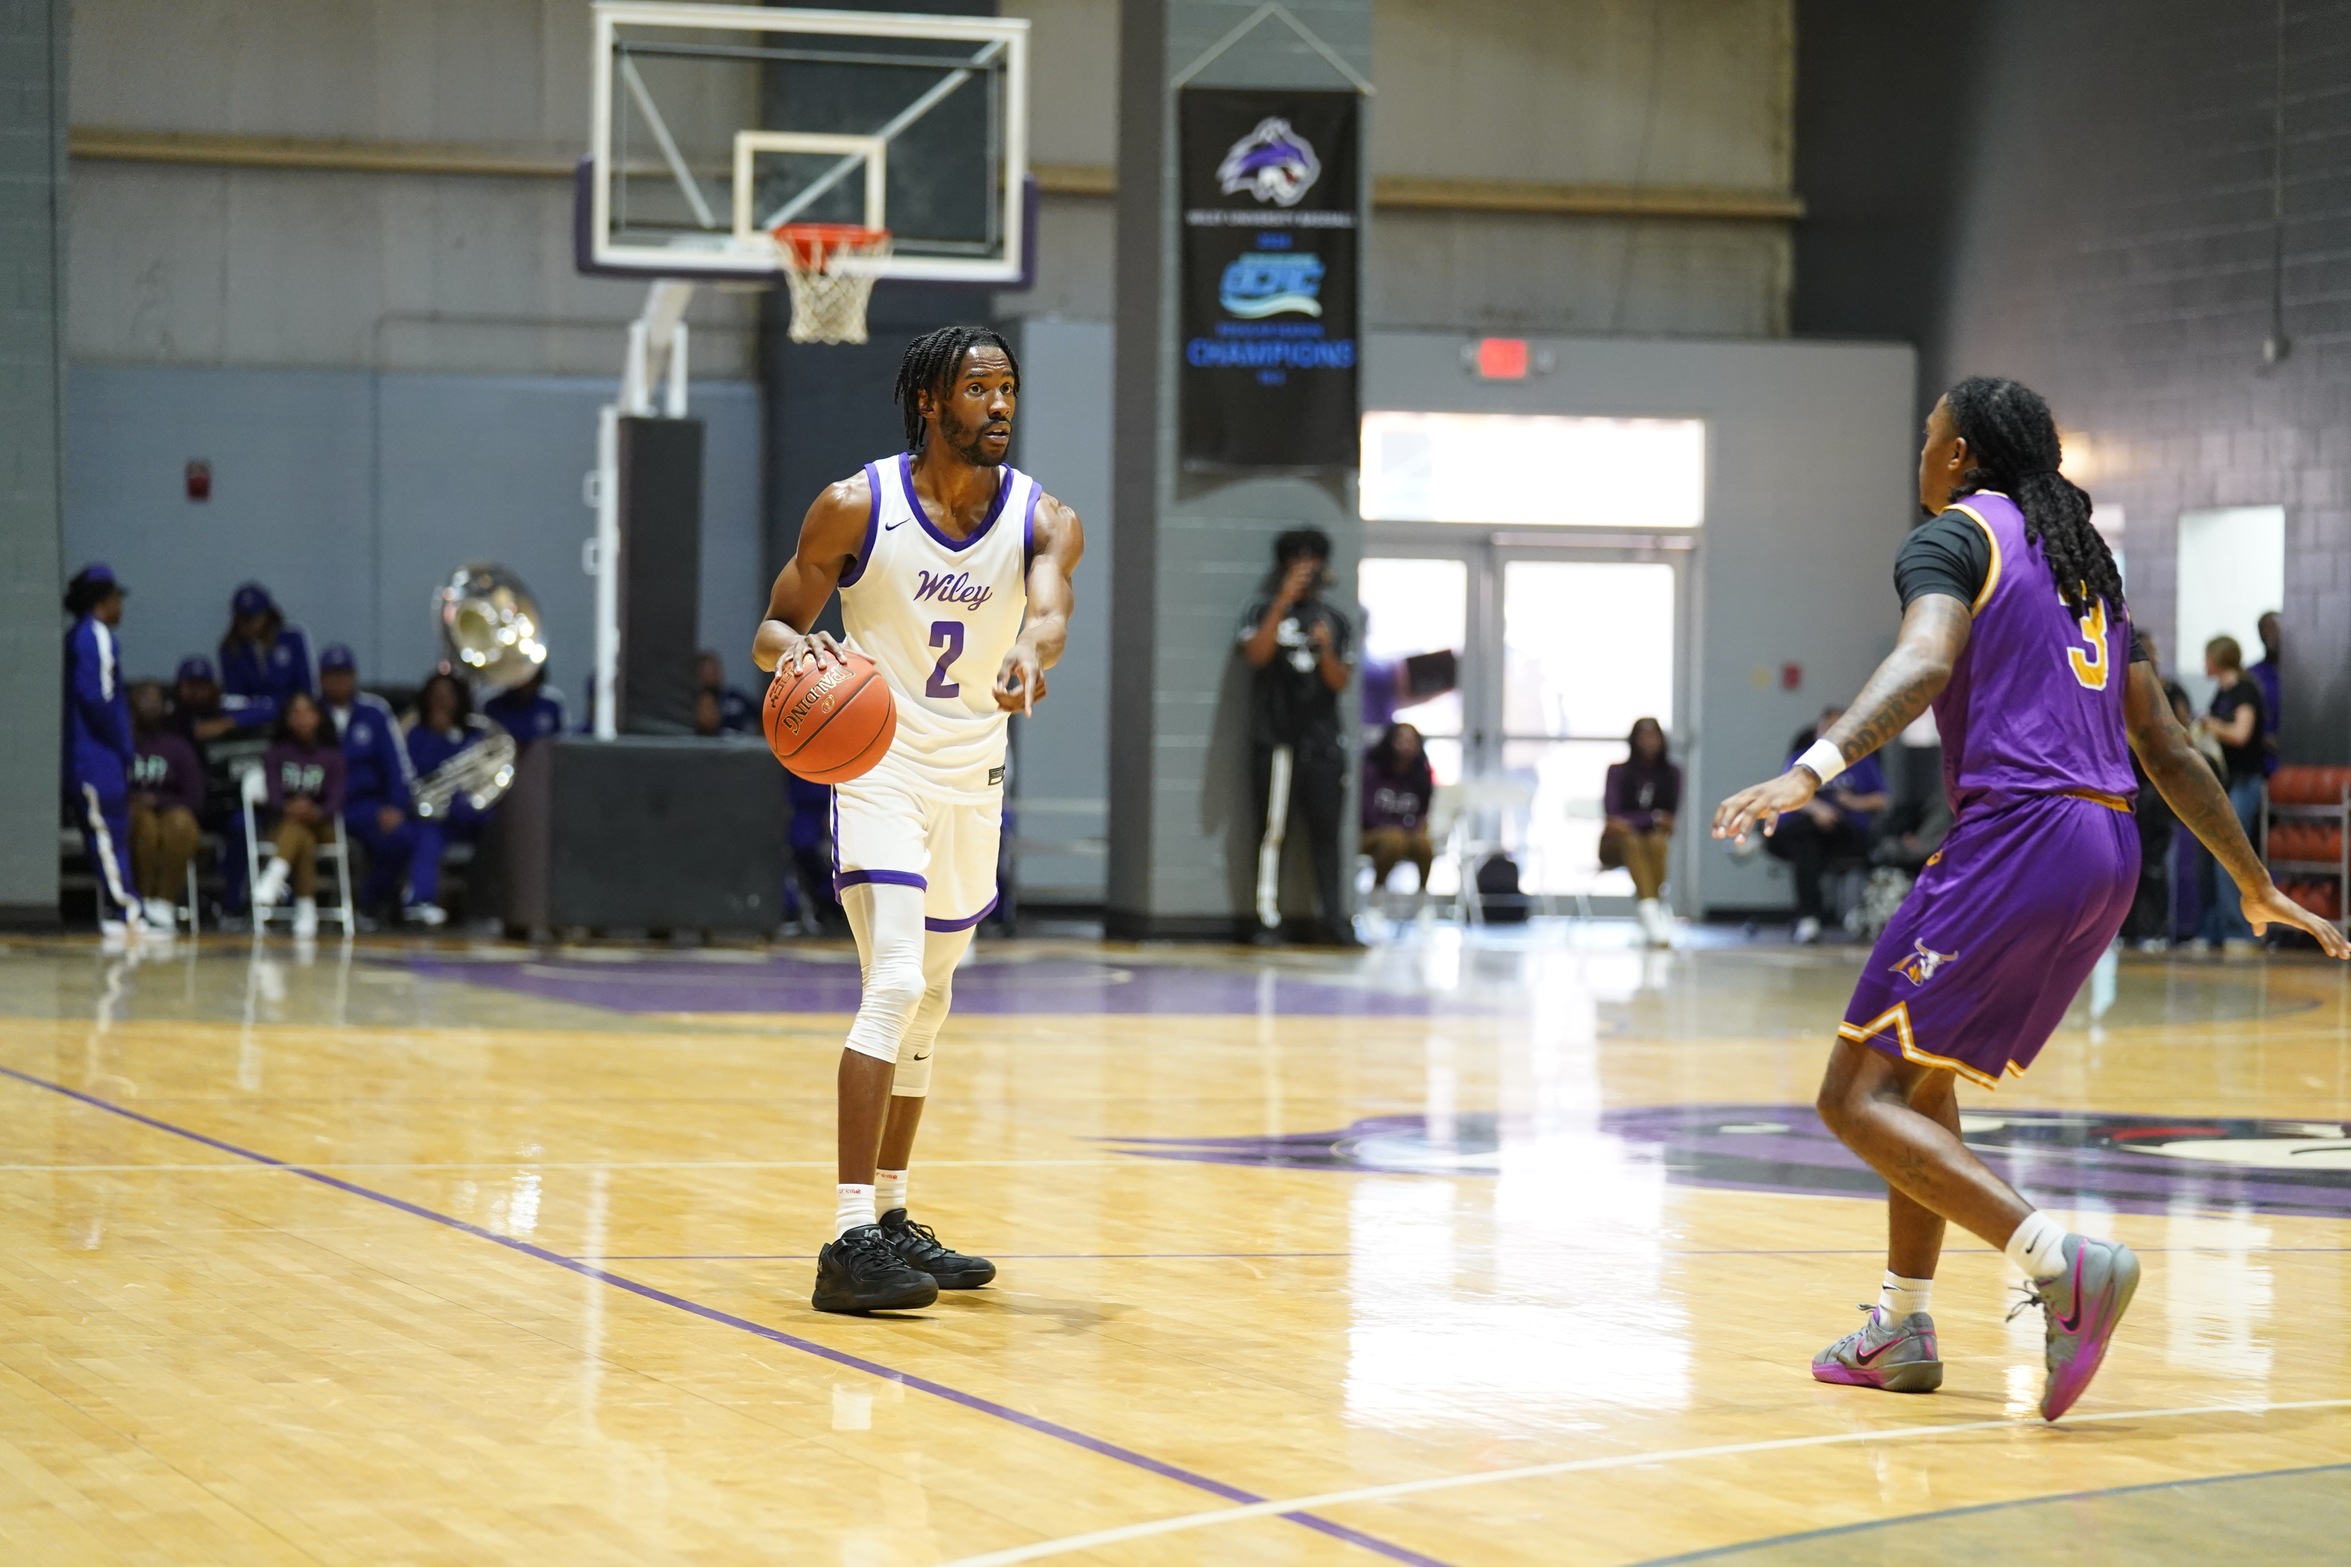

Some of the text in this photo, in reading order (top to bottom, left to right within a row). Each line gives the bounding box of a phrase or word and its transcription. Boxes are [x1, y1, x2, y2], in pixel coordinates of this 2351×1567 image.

[1187, 339, 1356, 366] CHAMPIONS
[913, 570, 993, 611] Wiley
[925, 621, 964, 698] 2
[2058, 579, 2109, 691] 3
